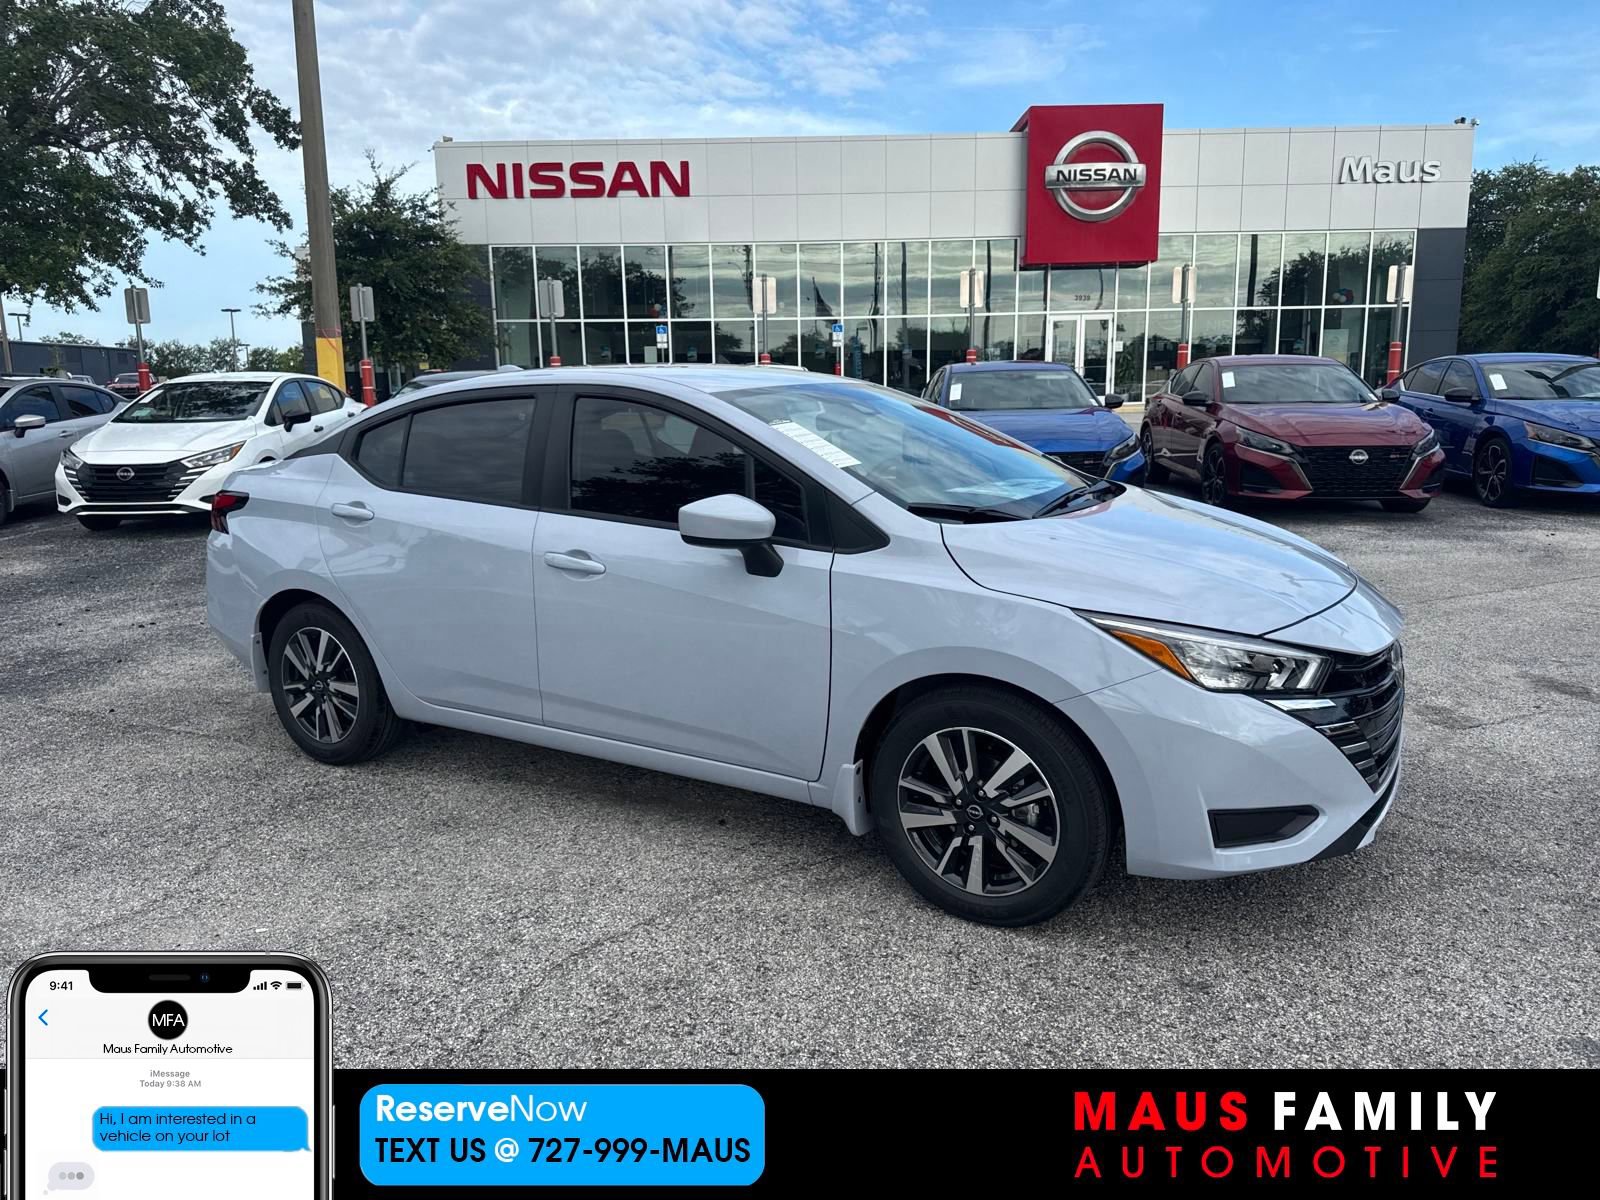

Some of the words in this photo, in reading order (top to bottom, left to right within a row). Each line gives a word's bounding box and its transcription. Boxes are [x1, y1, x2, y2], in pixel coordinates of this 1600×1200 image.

[466, 160, 690, 200] NISSAN
[1056, 168, 1137, 182] NISSAN
[1339, 156, 1441, 184] Maus
